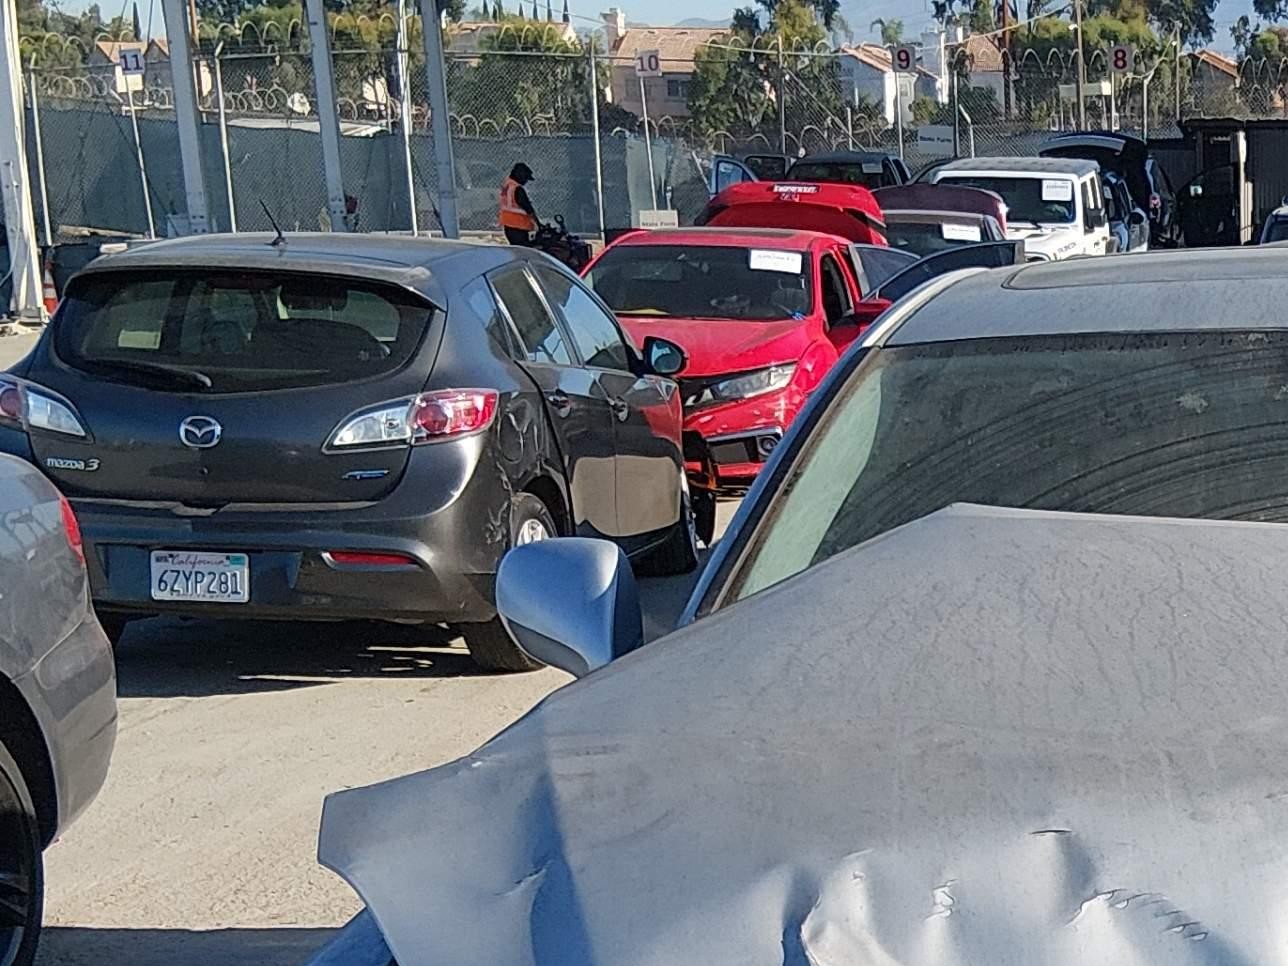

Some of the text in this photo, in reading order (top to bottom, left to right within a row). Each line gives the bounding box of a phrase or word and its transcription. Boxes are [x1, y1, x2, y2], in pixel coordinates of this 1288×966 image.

[120, 54, 143, 70] 11
[637, 55, 659, 71] 10
[897, 49, 910, 69] 9
[1113, 49, 1127, 69] 8
[170, 553, 224, 569] California
[158, 569, 242, 595] 6ZYP281
